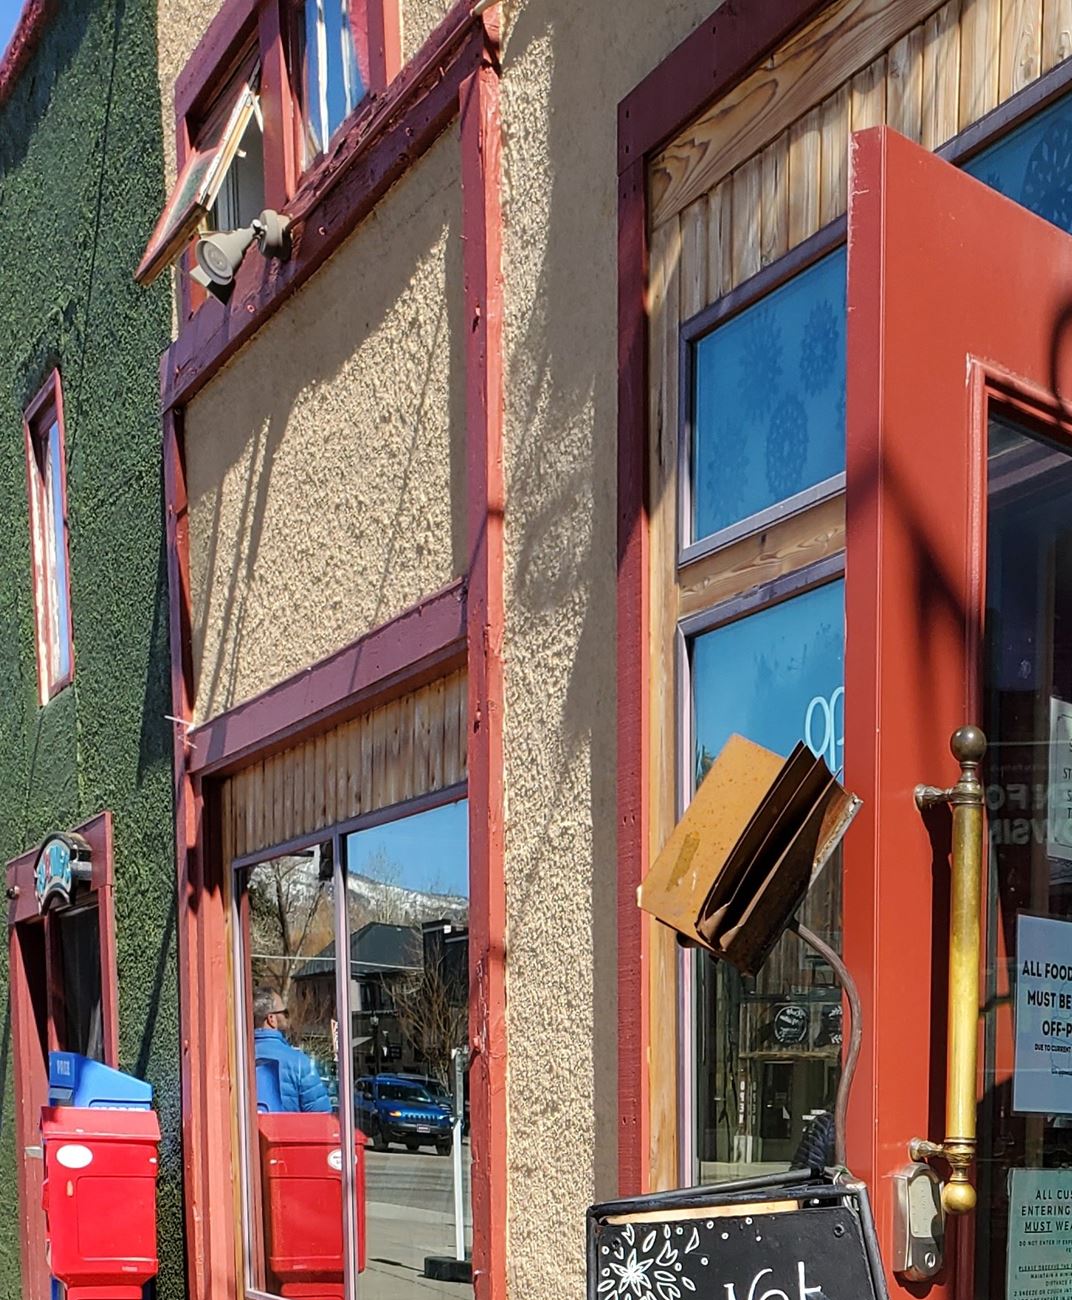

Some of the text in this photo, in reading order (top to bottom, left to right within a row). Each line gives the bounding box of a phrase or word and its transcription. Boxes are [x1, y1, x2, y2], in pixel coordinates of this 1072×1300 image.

[1022, 960, 1042, 977] ALL
[1027, 990, 1056, 1008] MUST
[1059, 993, 1071, 1010] BE
[1036, 1190, 1052, 1200] ALL
[1021, 1205, 1071, 1216] ENTERING
[1024, 1221, 1052, 1232] MUST
